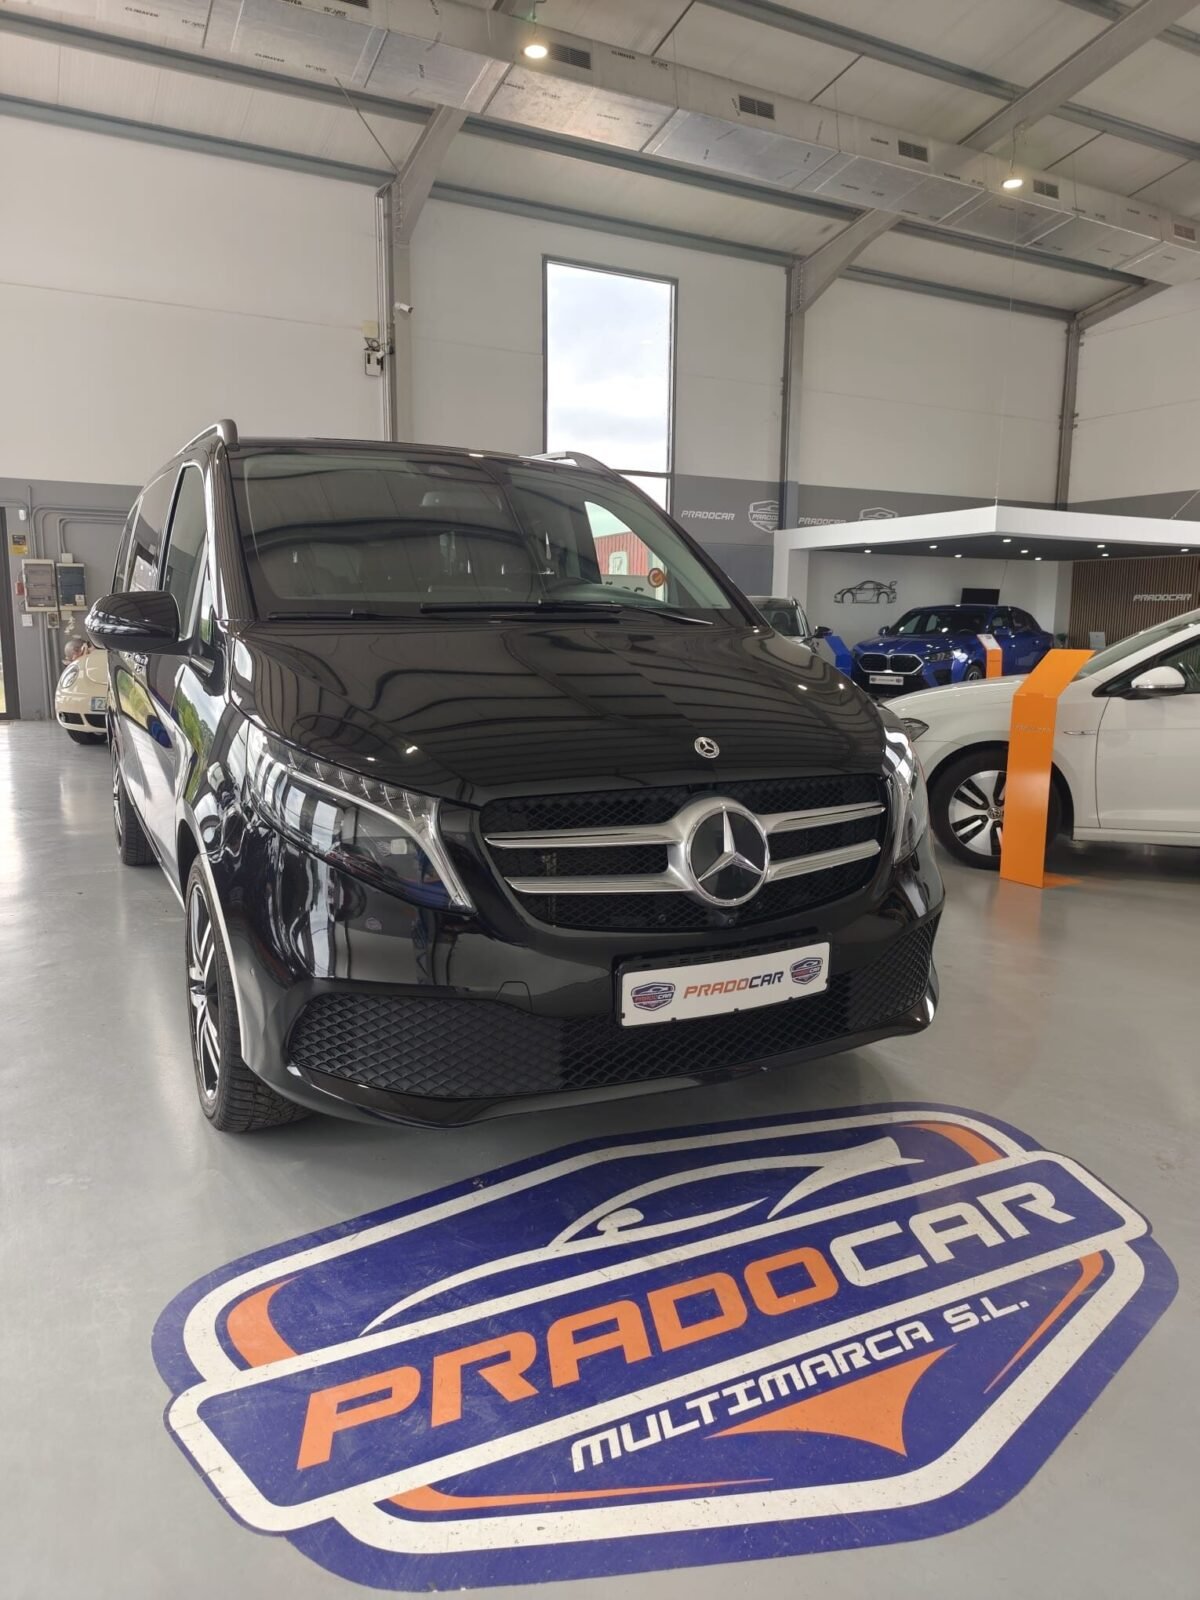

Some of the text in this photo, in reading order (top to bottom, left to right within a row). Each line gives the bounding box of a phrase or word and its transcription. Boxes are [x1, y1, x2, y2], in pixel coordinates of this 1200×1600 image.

[681, 510, 735, 521] PRADOCAR
[1133, 593, 1192, 602] PRADOCAR
[683, 971, 784, 999] PRADOCAR
[297, 1181, 1076, 1470] PRADOCAR
[571, 1296, 1029, 1473] MULTIMARCA S.L.
